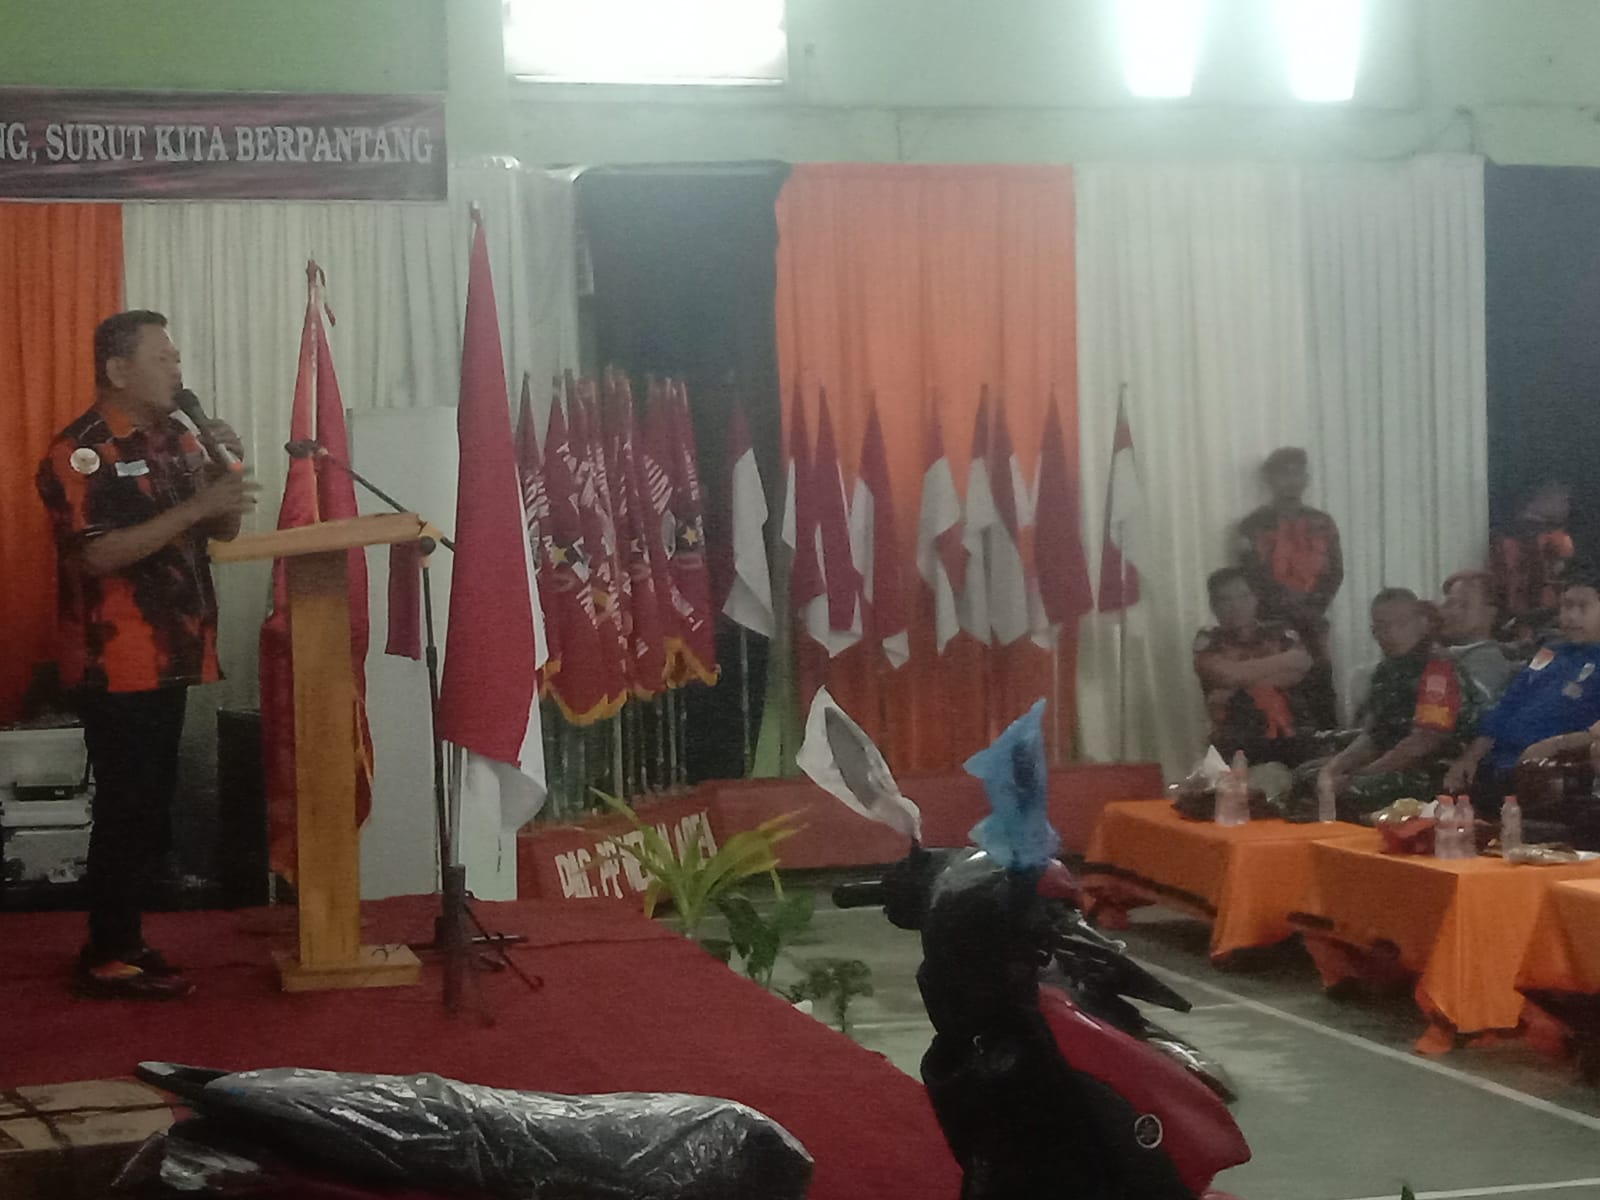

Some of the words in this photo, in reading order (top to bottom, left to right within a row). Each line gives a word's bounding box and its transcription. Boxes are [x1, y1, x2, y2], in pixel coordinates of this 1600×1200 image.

[46, 123, 146, 161] SURUT
[154, 125, 229, 161] KITA
[235, 126, 433, 163] BERPANTANG
